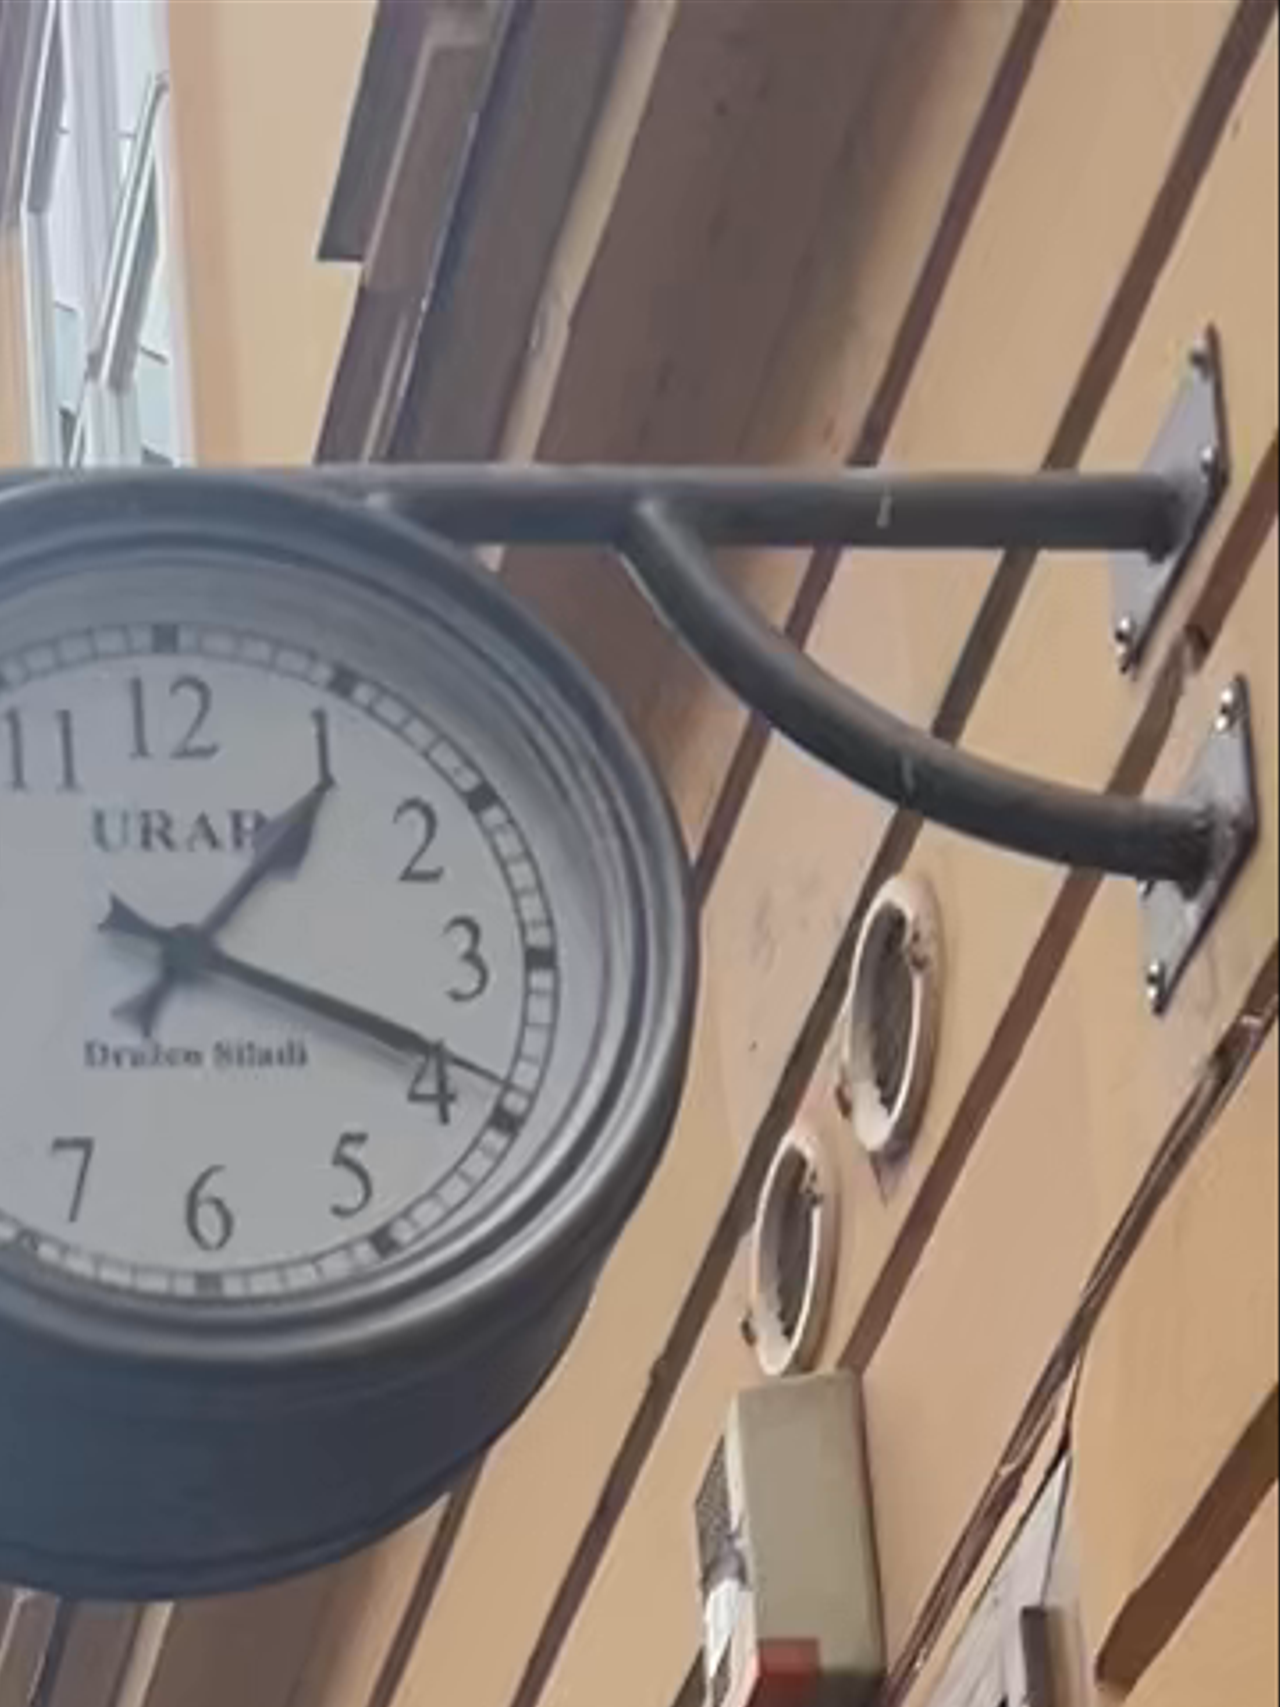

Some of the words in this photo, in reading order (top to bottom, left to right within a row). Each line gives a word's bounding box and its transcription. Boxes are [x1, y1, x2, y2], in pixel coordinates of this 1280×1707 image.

[4, 706, 84, 794] 11
[124, 674, 220, 760] 12
[308, 706, 337, 790] 1
[392, 798, 445, 883] 2
[441, 914, 491, 1003] 3
[405, 1038, 459, 1125] 4
[49, 1136, 96, 1225] 7
[183, 1163, 235, 1252] 6
[328, 1131, 375, 1219] 5
